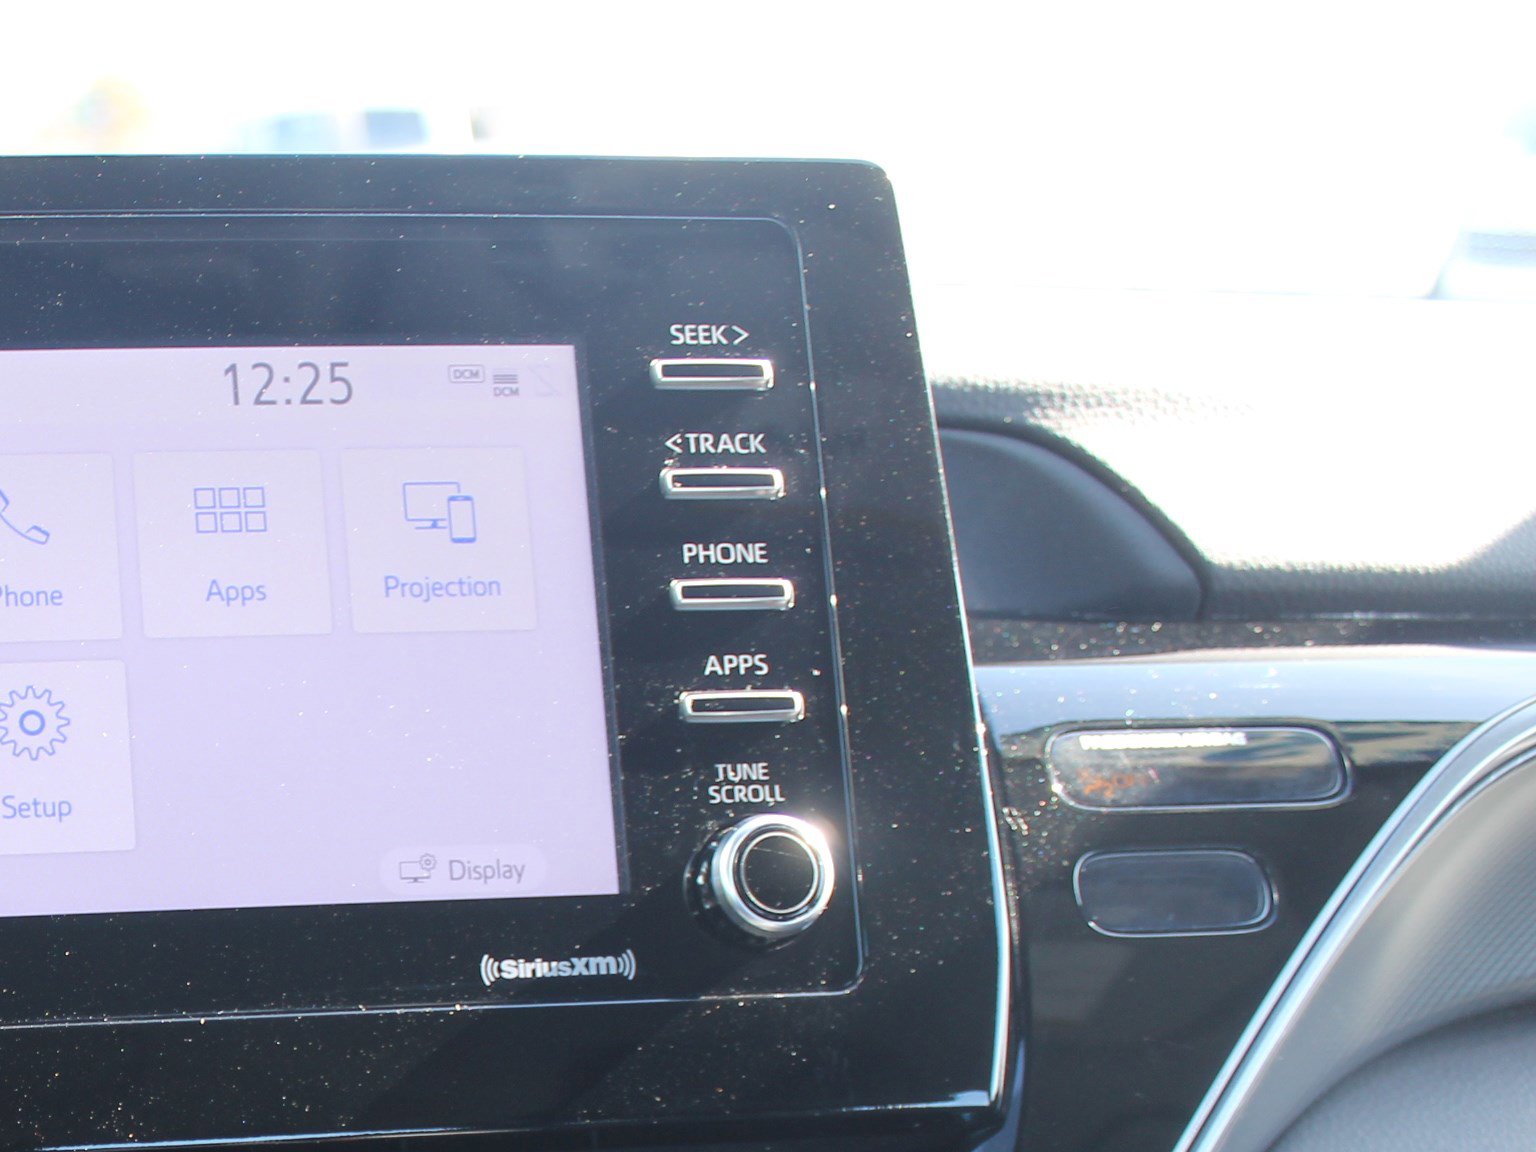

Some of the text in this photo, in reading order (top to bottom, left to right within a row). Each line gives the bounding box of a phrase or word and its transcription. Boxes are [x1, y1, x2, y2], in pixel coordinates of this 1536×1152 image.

[224, 362, 353, 405] 12:25
[493, 387, 519, 397] DCM
[682, 543, 768, 564] PHONE
[206, 579, 266, 606] Apps
[384, 575, 501, 602] Projection
[704, 655, 768, 675] APPS
[715, 762, 769, 782] TUNE
[708, 785, 785, 804] SCROLL
[2, 796, 72, 822] Setup
[449, 859, 525, 883] Display
